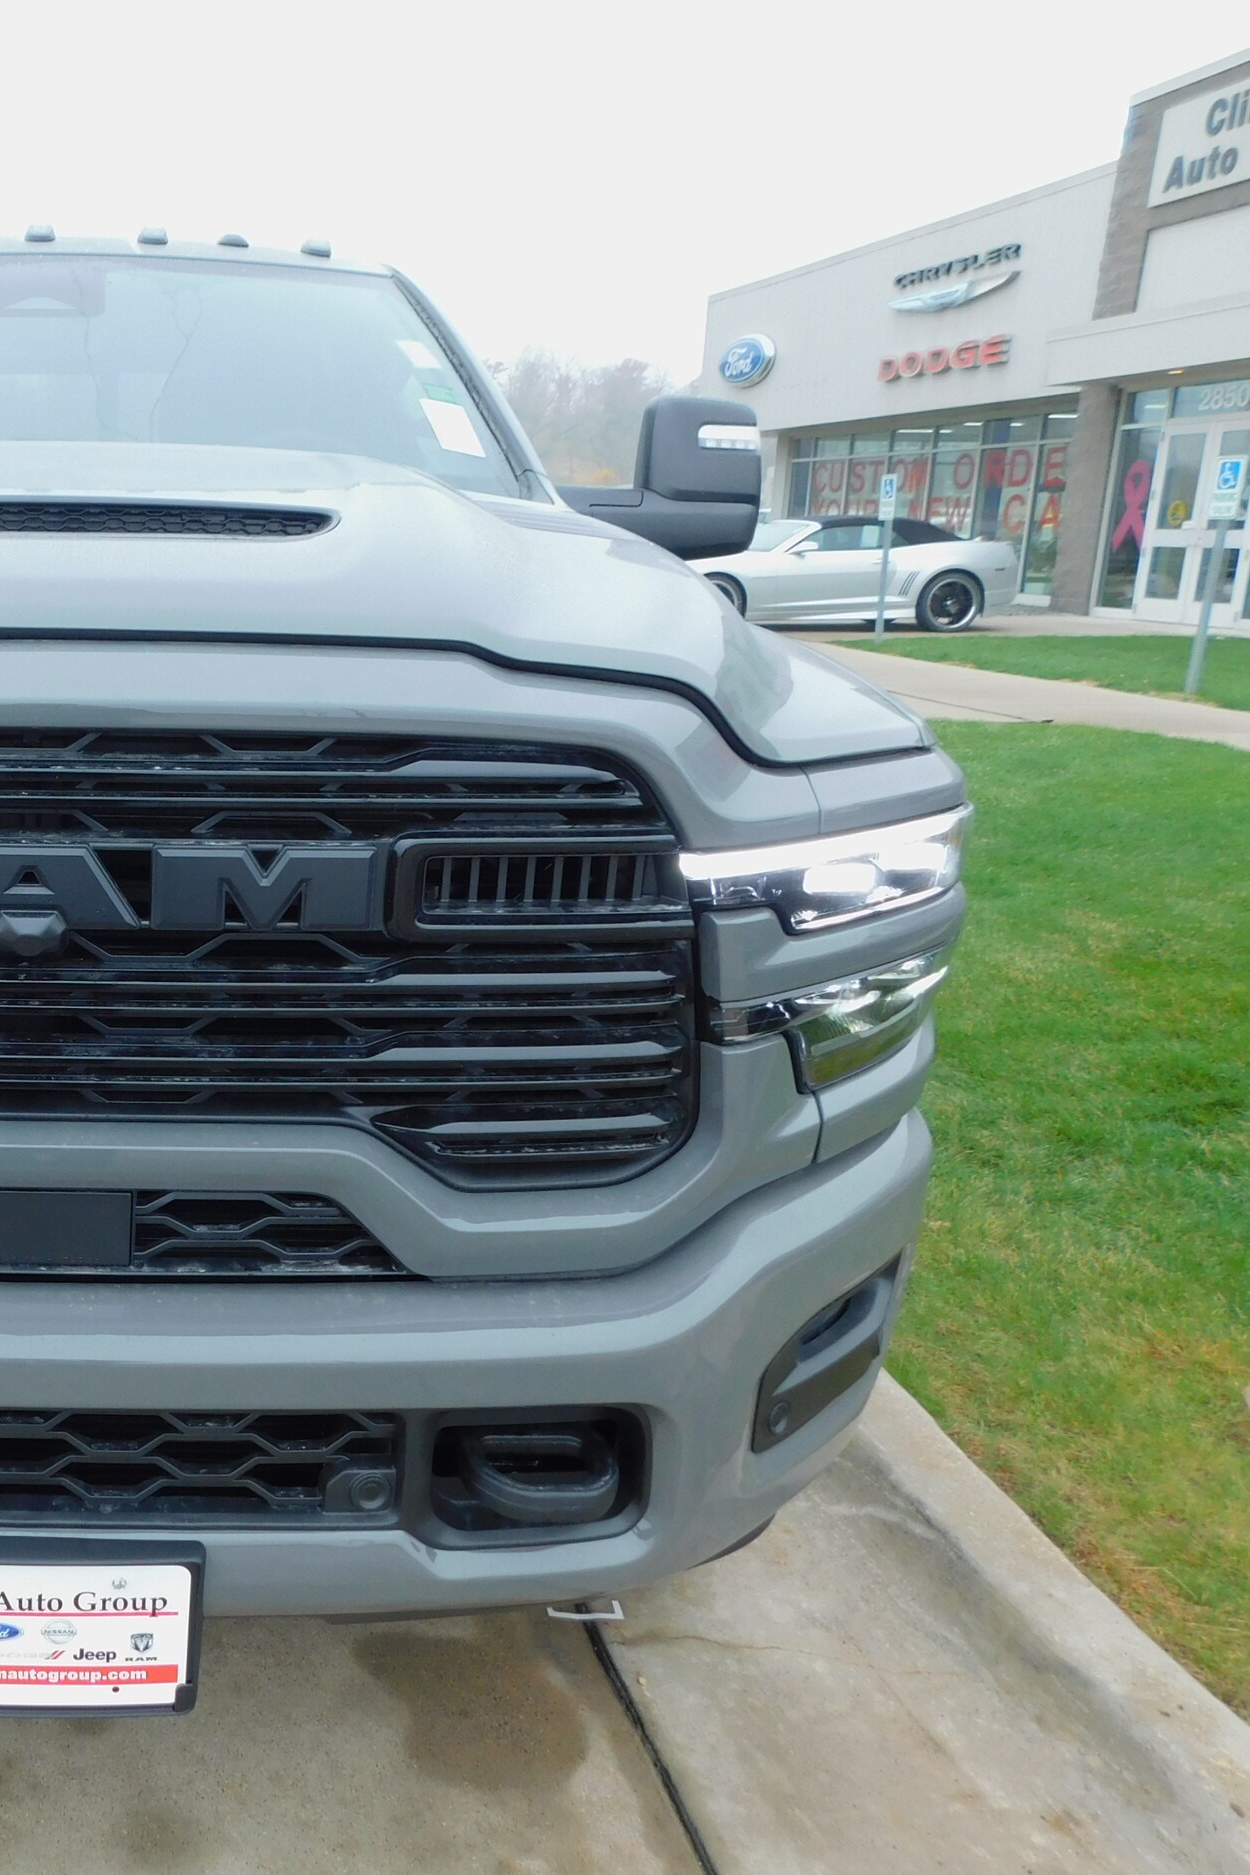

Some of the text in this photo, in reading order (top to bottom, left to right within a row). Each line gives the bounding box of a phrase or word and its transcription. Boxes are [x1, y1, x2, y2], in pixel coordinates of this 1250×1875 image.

[1205, 88, 1250, 138] Cli
[1162, 146, 1239, 193] Auto
[893, 242, 1022, 289] CHRYSLER
[877, 334, 1012, 382] DODGE
[1198, 383, 1250, 411] 2850
[812, 457, 930, 495] CUSTOM
[72, 1591, 168, 1618] Group
[72, 1648, 117, 1663] Jeep
